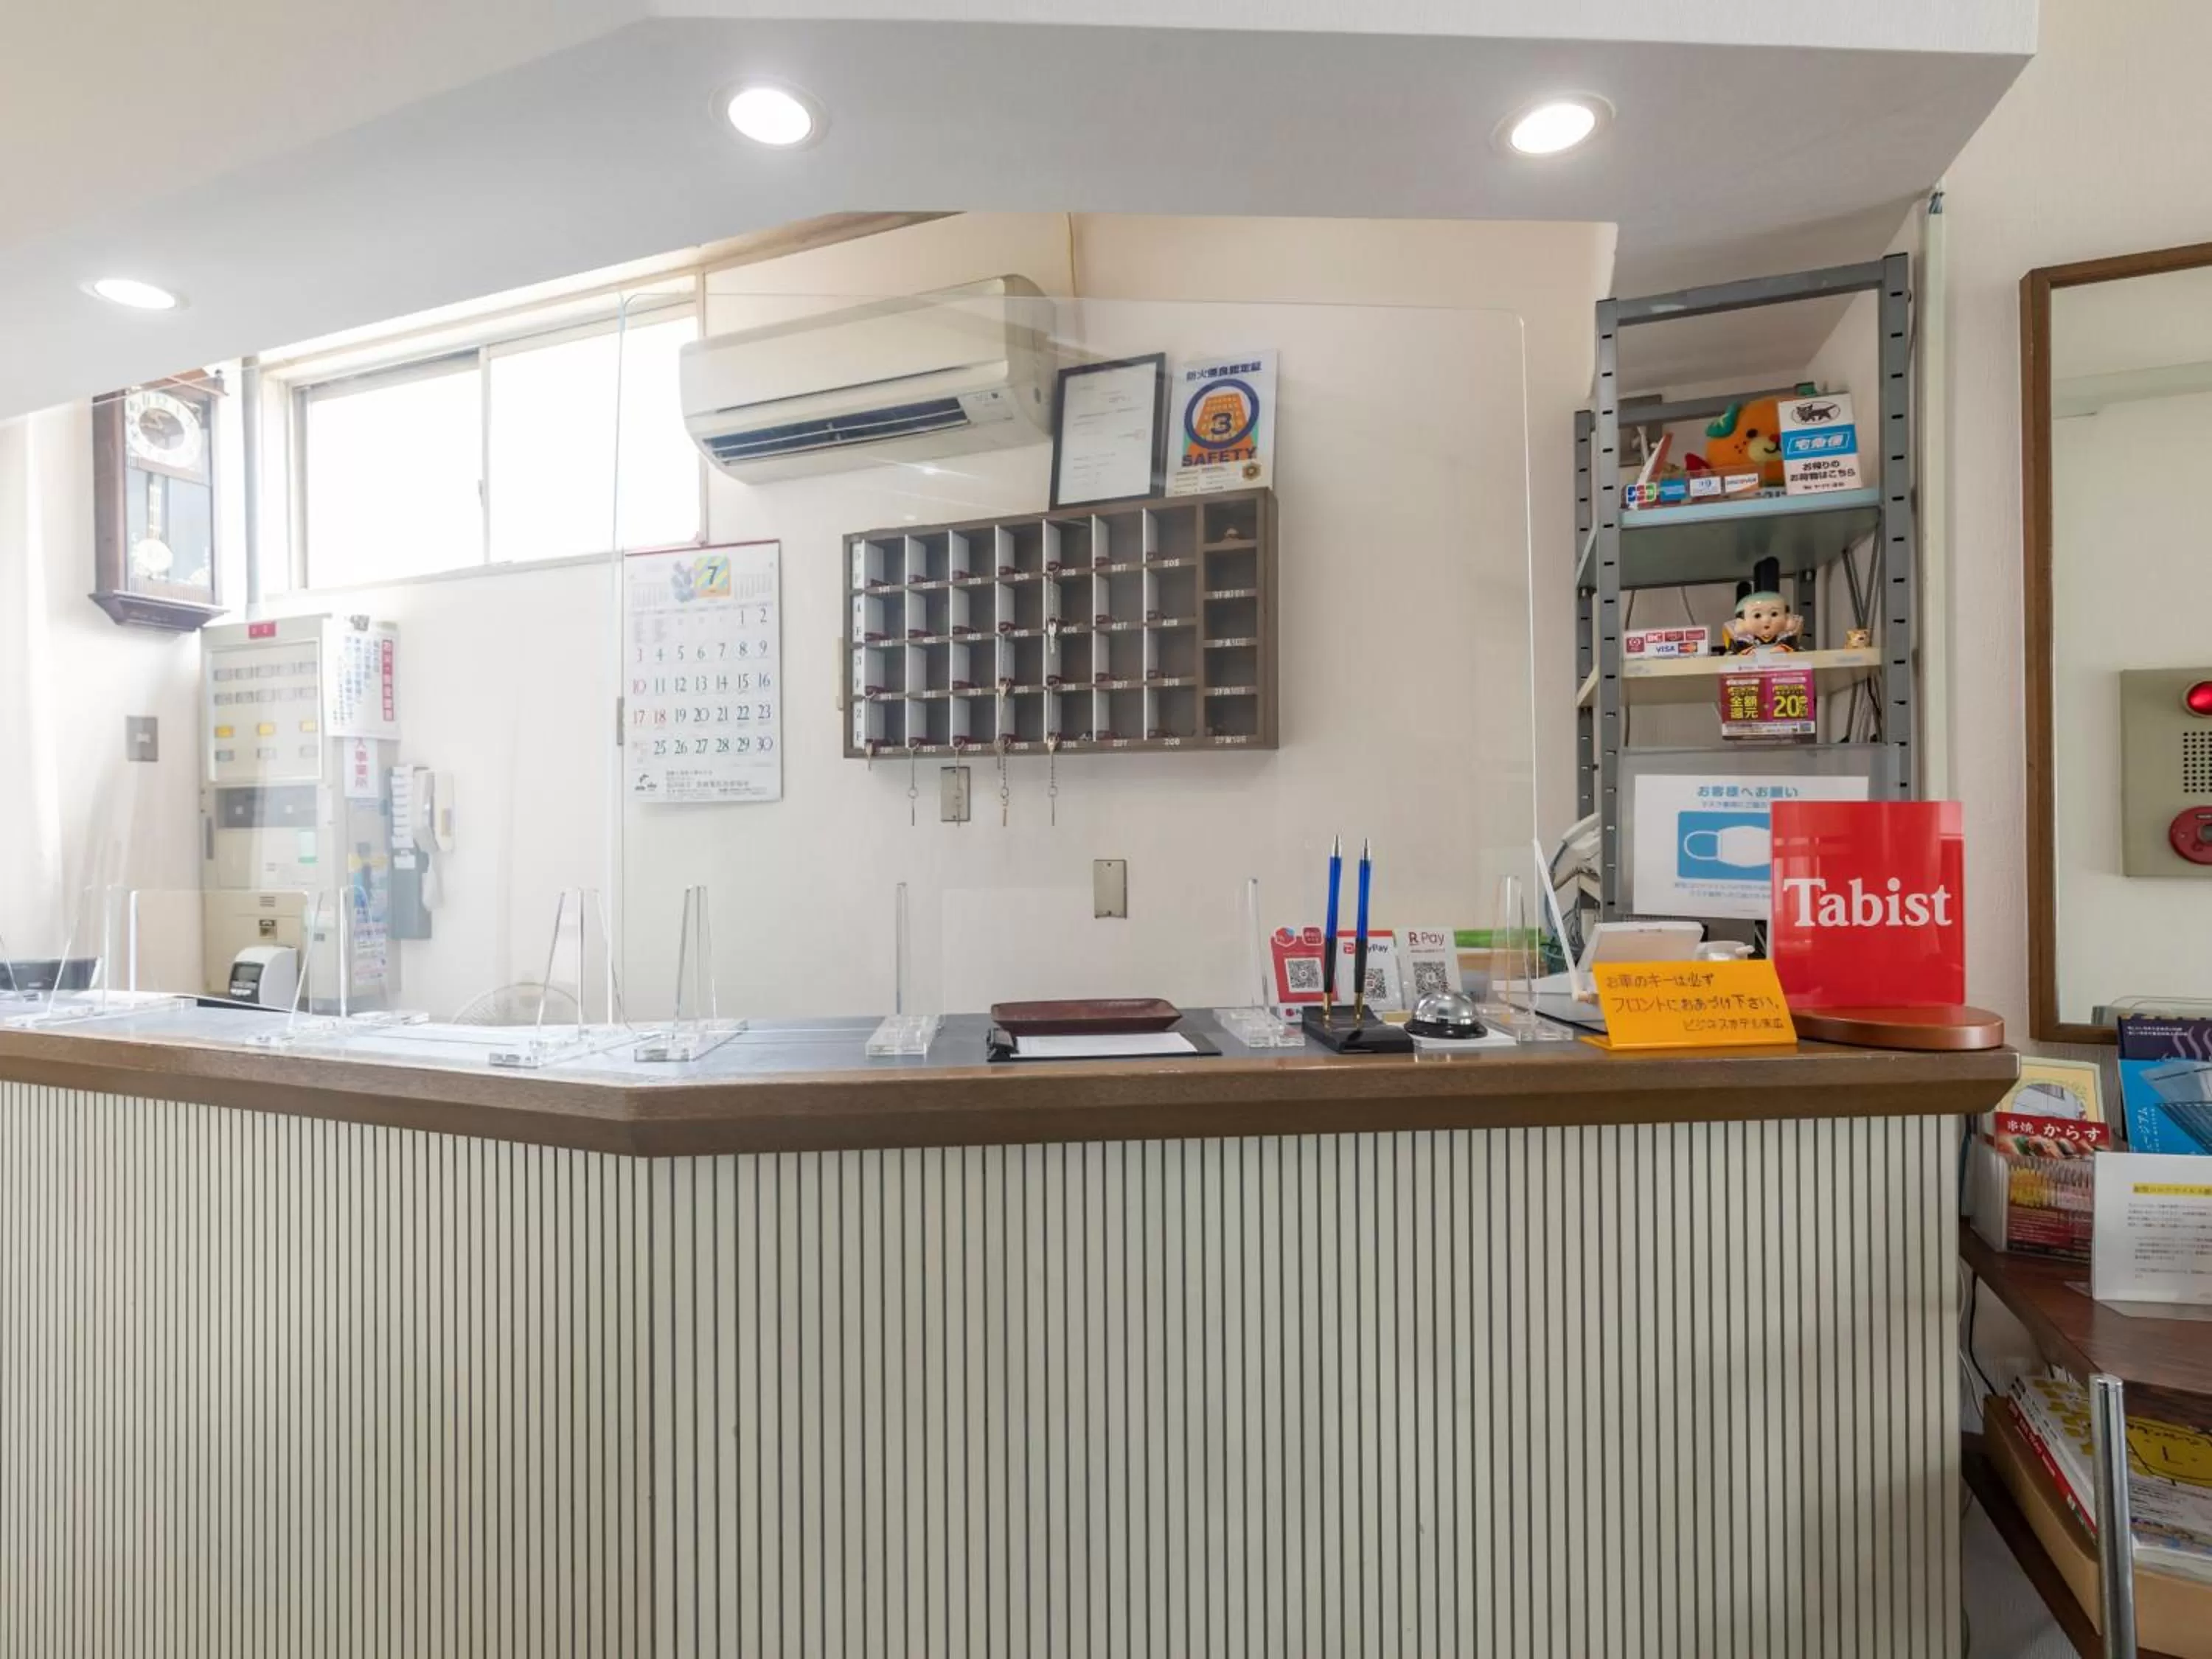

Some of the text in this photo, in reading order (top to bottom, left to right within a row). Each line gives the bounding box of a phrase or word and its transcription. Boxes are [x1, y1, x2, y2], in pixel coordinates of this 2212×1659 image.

[1211, 412, 1232, 435] 3
[1181, 447, 1257, 467] SAFETY
[707, 566, 718, 585] 7
[759, 608, 768, 624] 2
[655, 648, 664, 662] 4
[677, 645, 684, 661] 5
[697, 645, 706, 659] 6
[718, 643, 726, 658] 7
[738, 641, 748, 656] 8
[759, 640, 768, 655] 9
[1656, 645, 1675, 653] VISA
[632, 672, 771, 694] 10 11 12 13 14 15 16
[633, 704, 771, 726] 17 18 19 20 21 22 23
[653, 736, 773, 755] 25 26 27 28 29 30
[1697, 785, 1798, 798] お客様へお願い
[1783, 877, 1953, 928] Tabist
[1421, 931, 1445, 945] Pay
[1366, 942, 1388, 954] yPay
[1606, 972, 1715, 989] お車のキーは必ず
[2007, 1120, 2101, 1142] 串焼 からす
